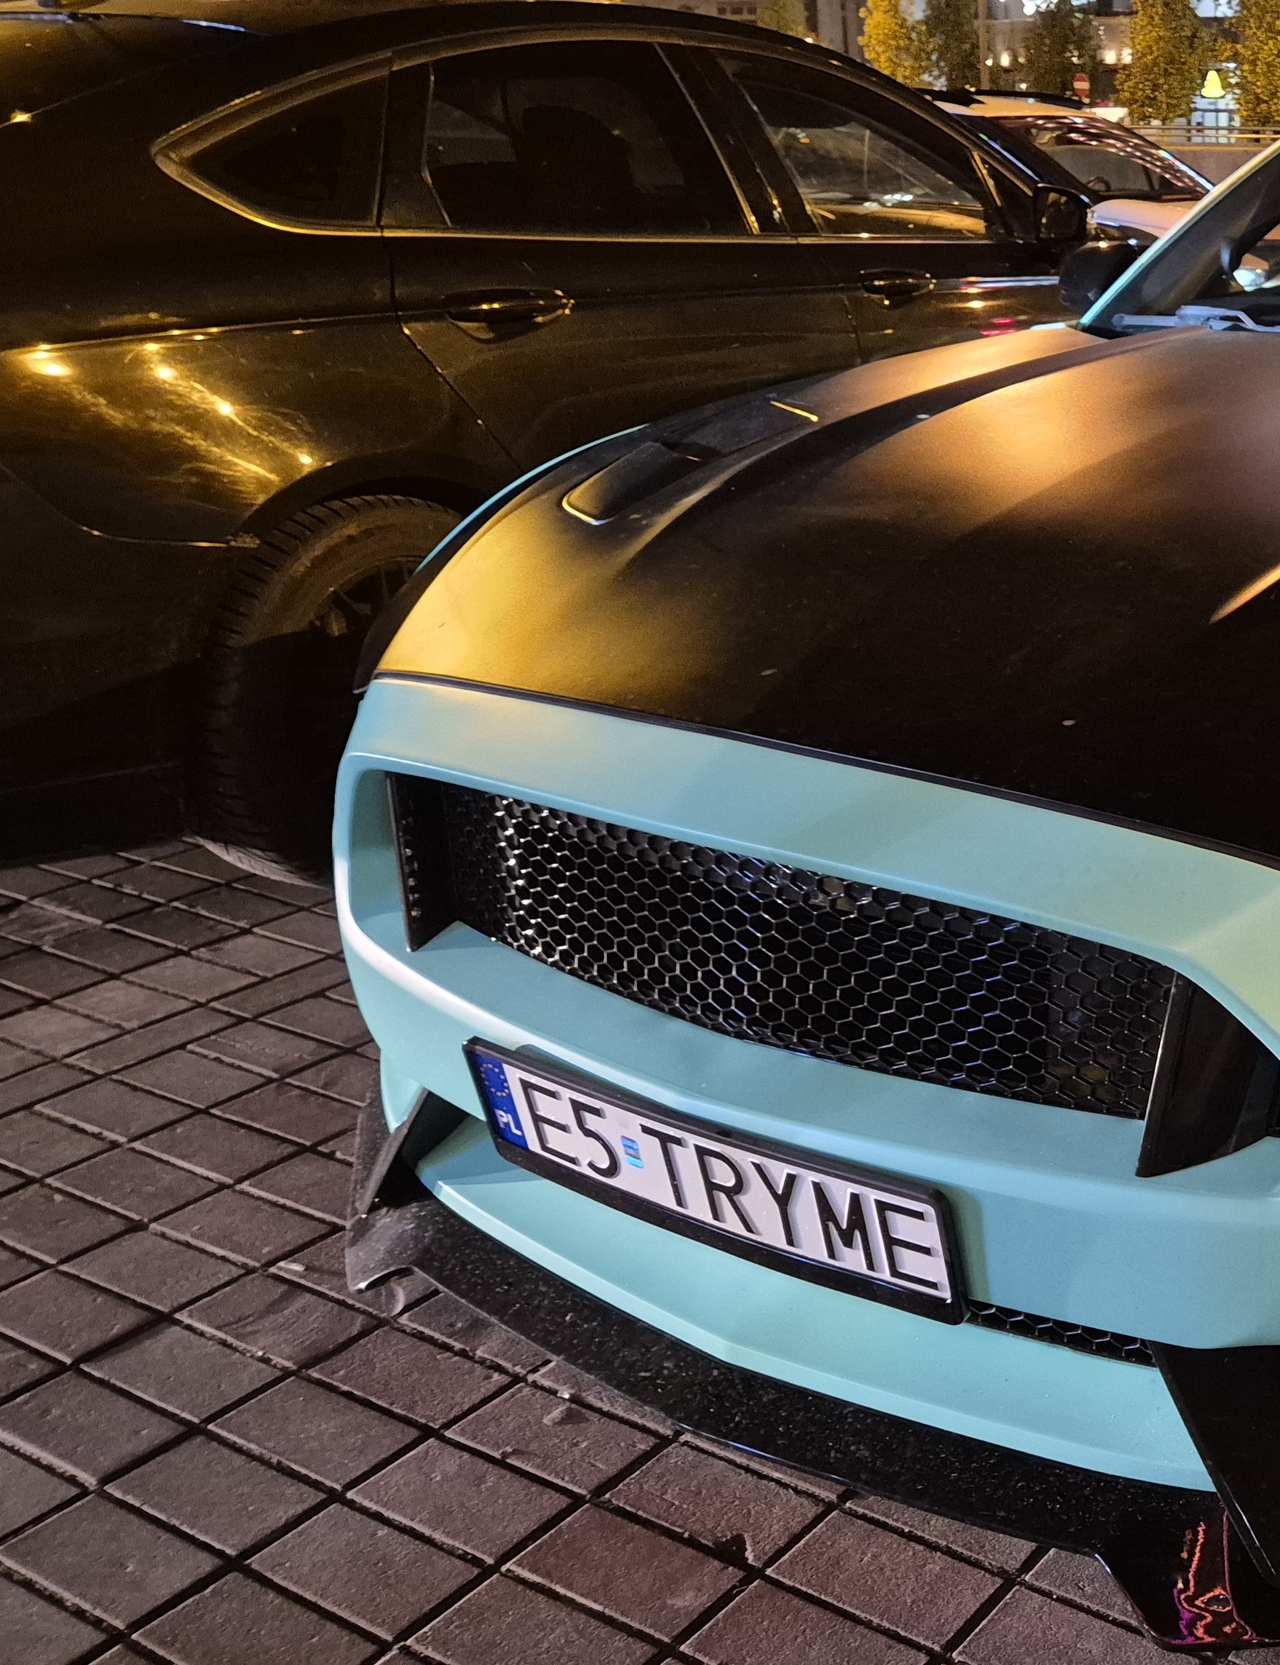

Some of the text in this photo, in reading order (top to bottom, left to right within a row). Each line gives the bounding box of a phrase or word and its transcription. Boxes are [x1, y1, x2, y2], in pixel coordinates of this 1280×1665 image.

[494, 1108, 522, 1136] PL
[518, 1077, 940, 1291] E5 TRYME
